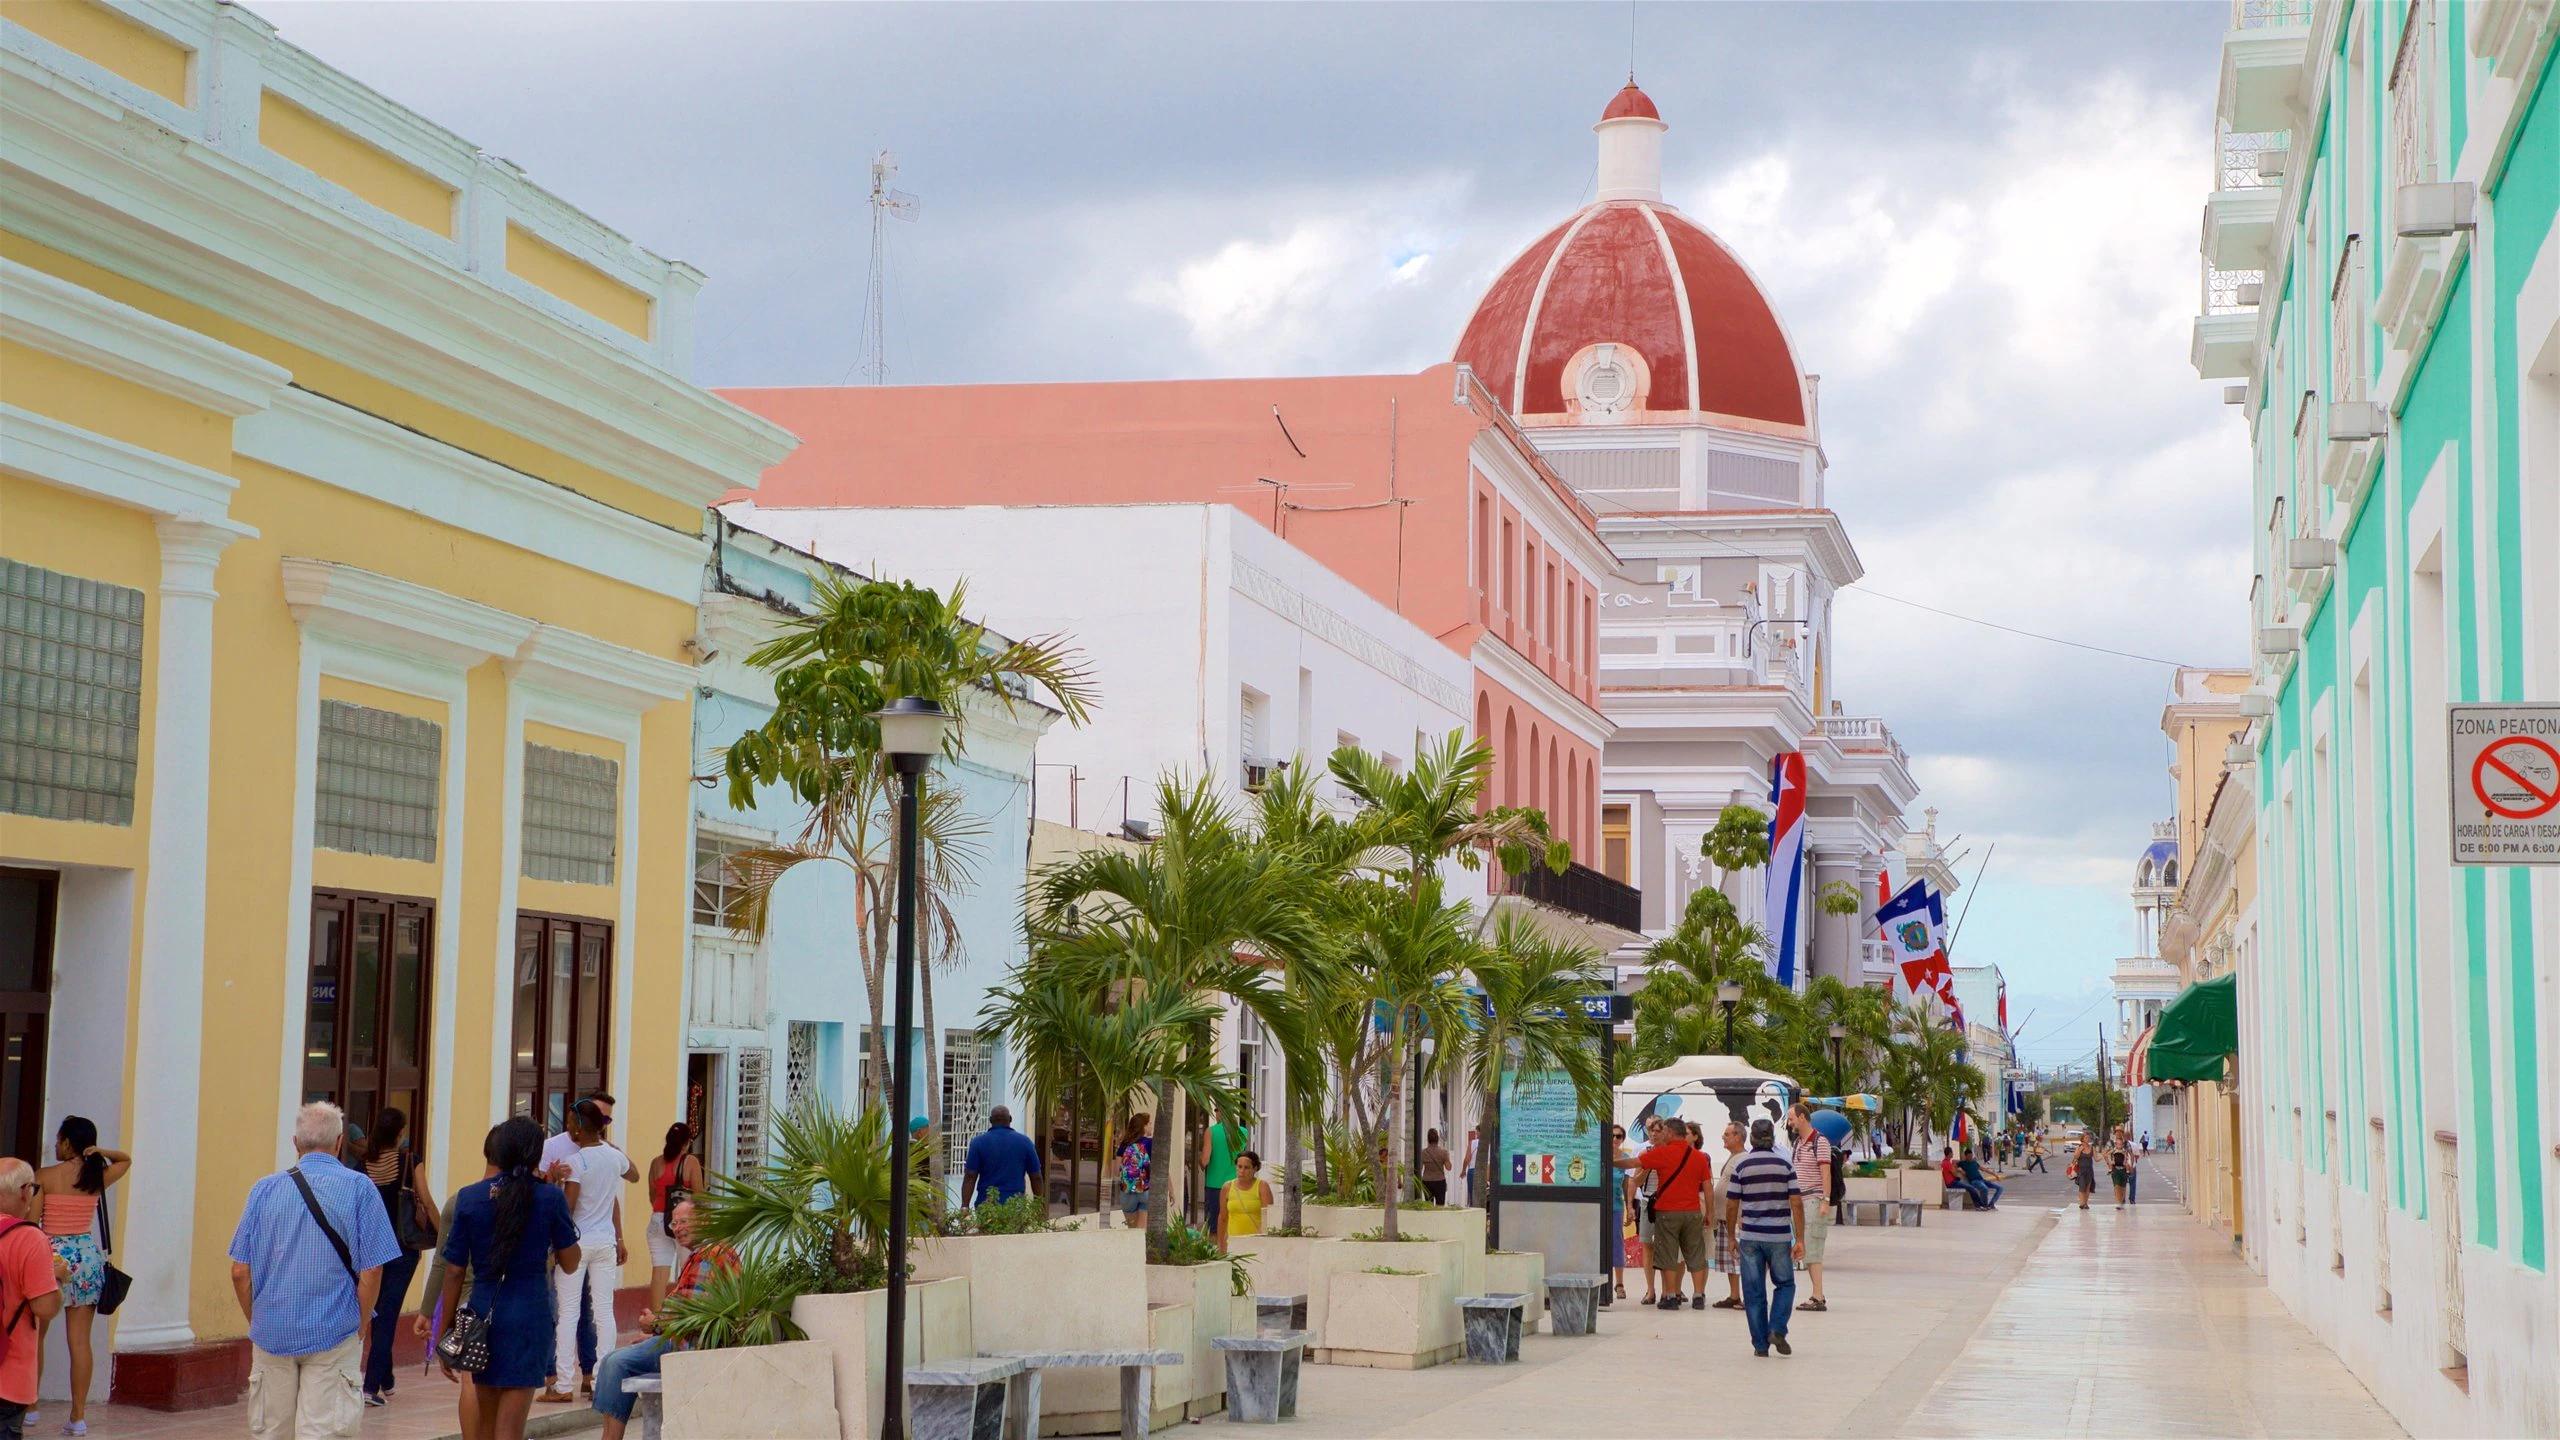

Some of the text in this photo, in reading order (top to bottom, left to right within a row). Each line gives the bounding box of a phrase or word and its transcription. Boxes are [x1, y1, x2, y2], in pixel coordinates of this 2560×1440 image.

[2456, 718, 2560, 735] ZONA PEATON
[2457, 824, 2490, 838] HORARIO
[2492, 824, 2502, 838] DE
[2503, 824, 2529, 838] CARGA
[2531, 825, 2536, 838] Y
[2460, 843, 2475, 853] DE
[2478, 843, 2500, 853] 6:00
[2503, 843, 2519, 853] PM
[2522, 843, 2530, 853] A
[2532, 843, 2555, 853] 6:00
